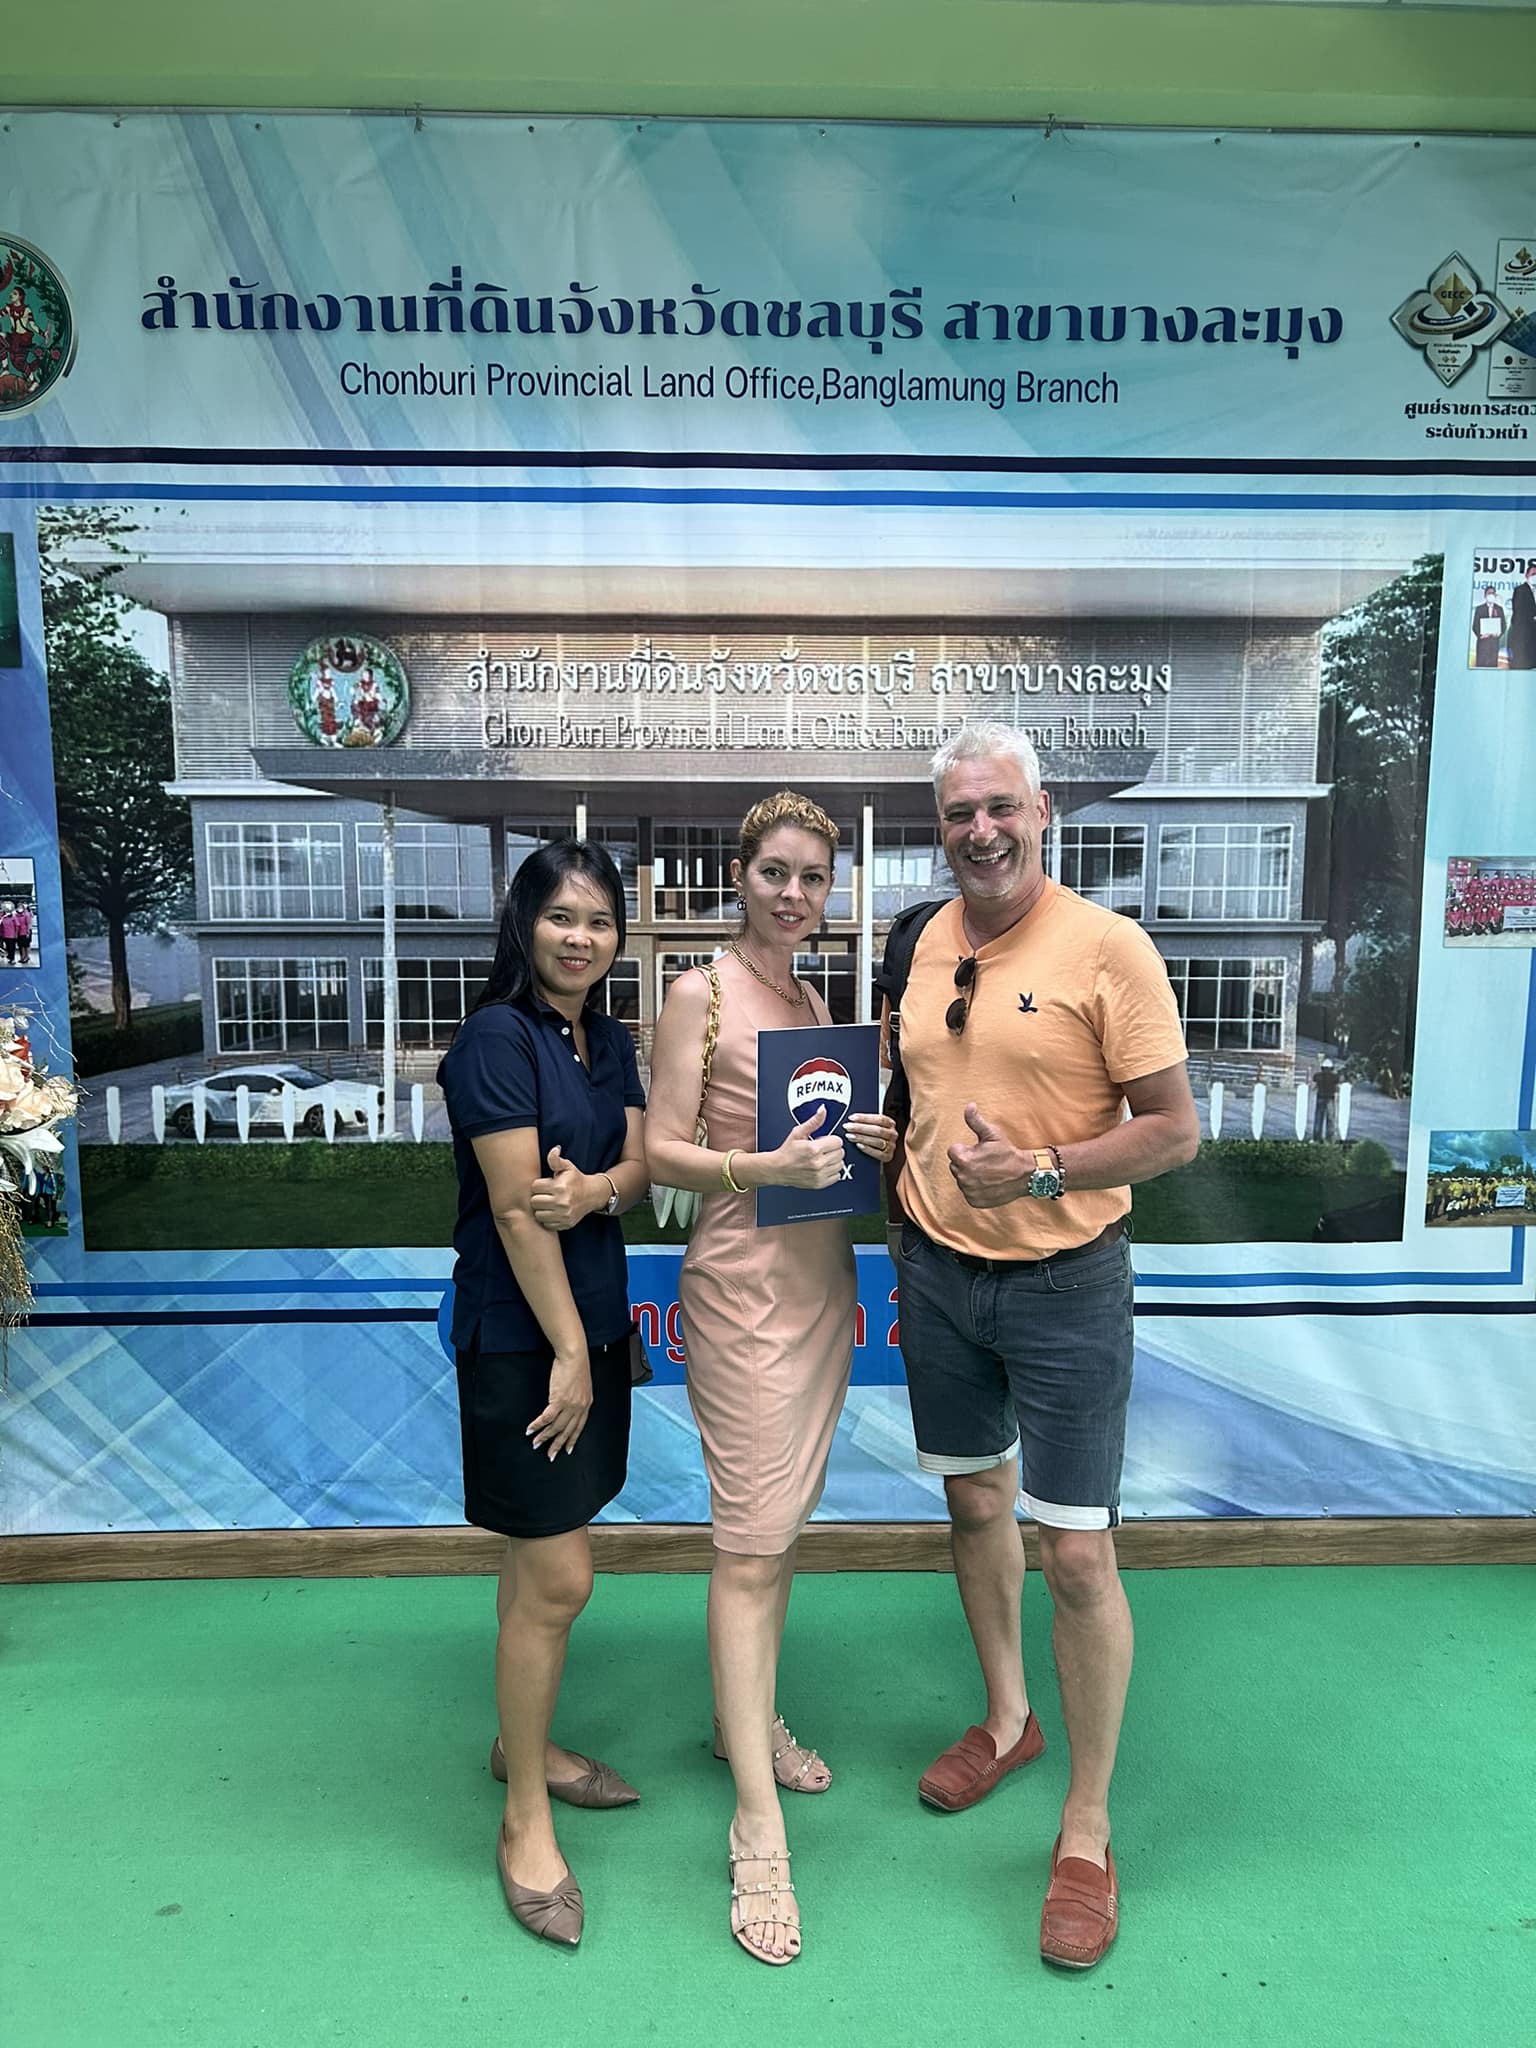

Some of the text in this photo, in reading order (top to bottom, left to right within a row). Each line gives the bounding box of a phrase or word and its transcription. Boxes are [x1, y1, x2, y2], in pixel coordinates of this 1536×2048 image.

[141, 265, 1345, 359] สำนักงานที่ดินจังหวัดชลบุรี สาขาบางละมุง
[1440, 291, 1465, 299] GECC
[340, 362, 476, 396] Chonburi
[487, 363, 632, 397] Provincial
[643, 365, 714, 398] Land
[1016, 370, 1119, 403] Branch
[1425, 422, 1528, 439] ระดับก้าวหน้า
[466, 638, 1172, 706] สำนักงานที่ดินจังหวัดชลบุรี สาขาบางละมุง
[484, 708, 549, 747] Chon
[1064, 711, 1150, 747] Branch
[796, 1080, 844, 1098] RE/MAX
